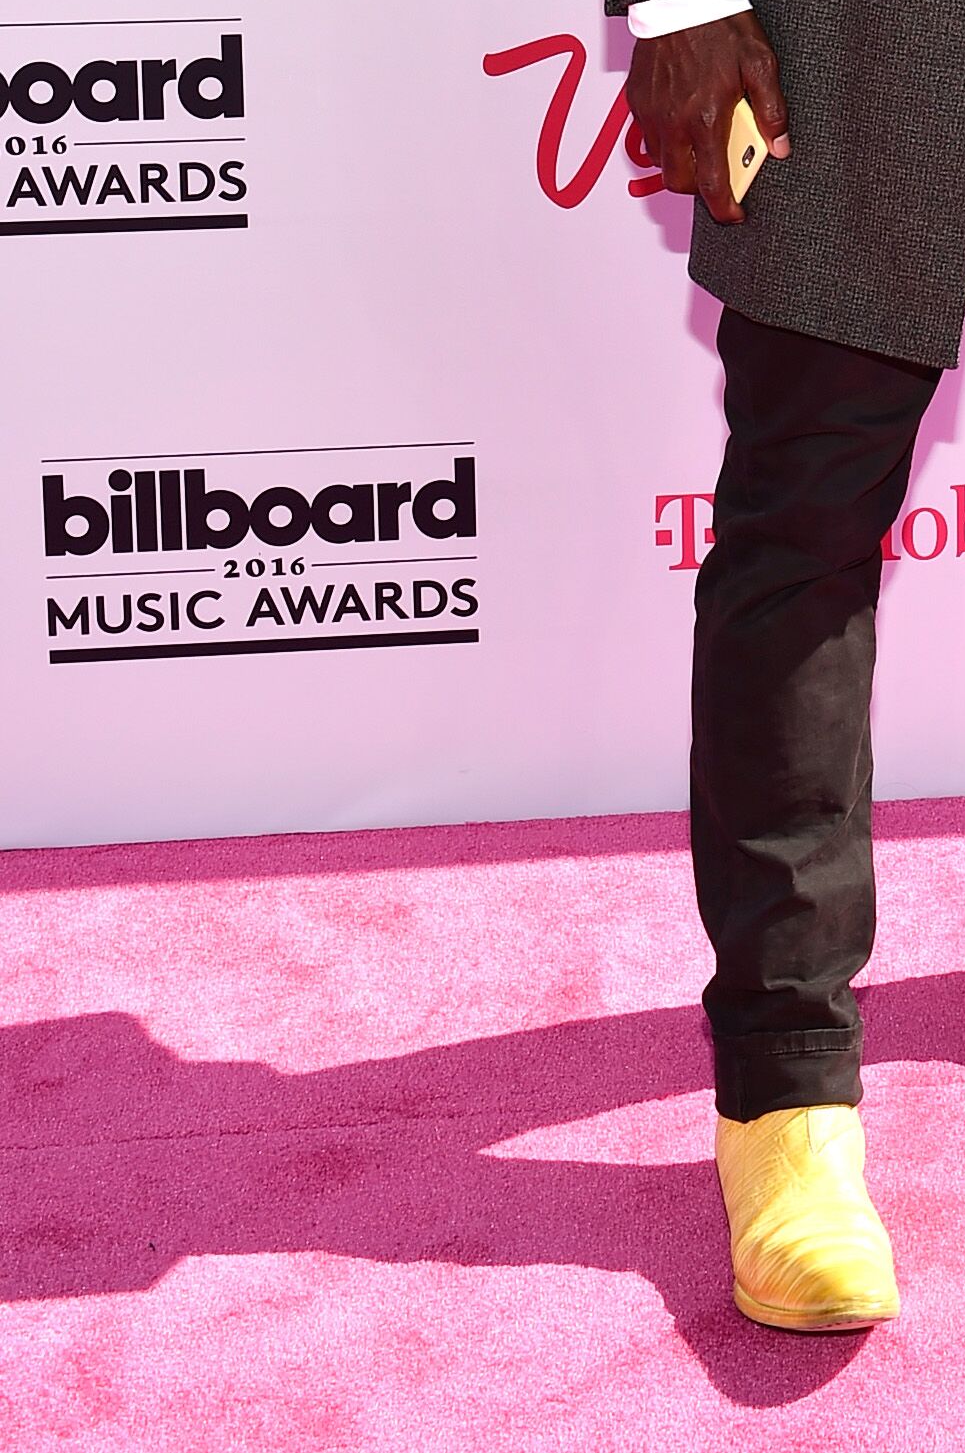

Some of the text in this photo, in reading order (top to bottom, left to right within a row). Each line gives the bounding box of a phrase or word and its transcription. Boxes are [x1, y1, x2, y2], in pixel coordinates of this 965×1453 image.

[0, 34, 244, 124] oard
[6, 161, 246, 207] AWARDS
[42, 457, 477, 556] billboard
[223, 557, 305, 578] 2016
[47, 579, 478, 636] MUSIC AWARDS
